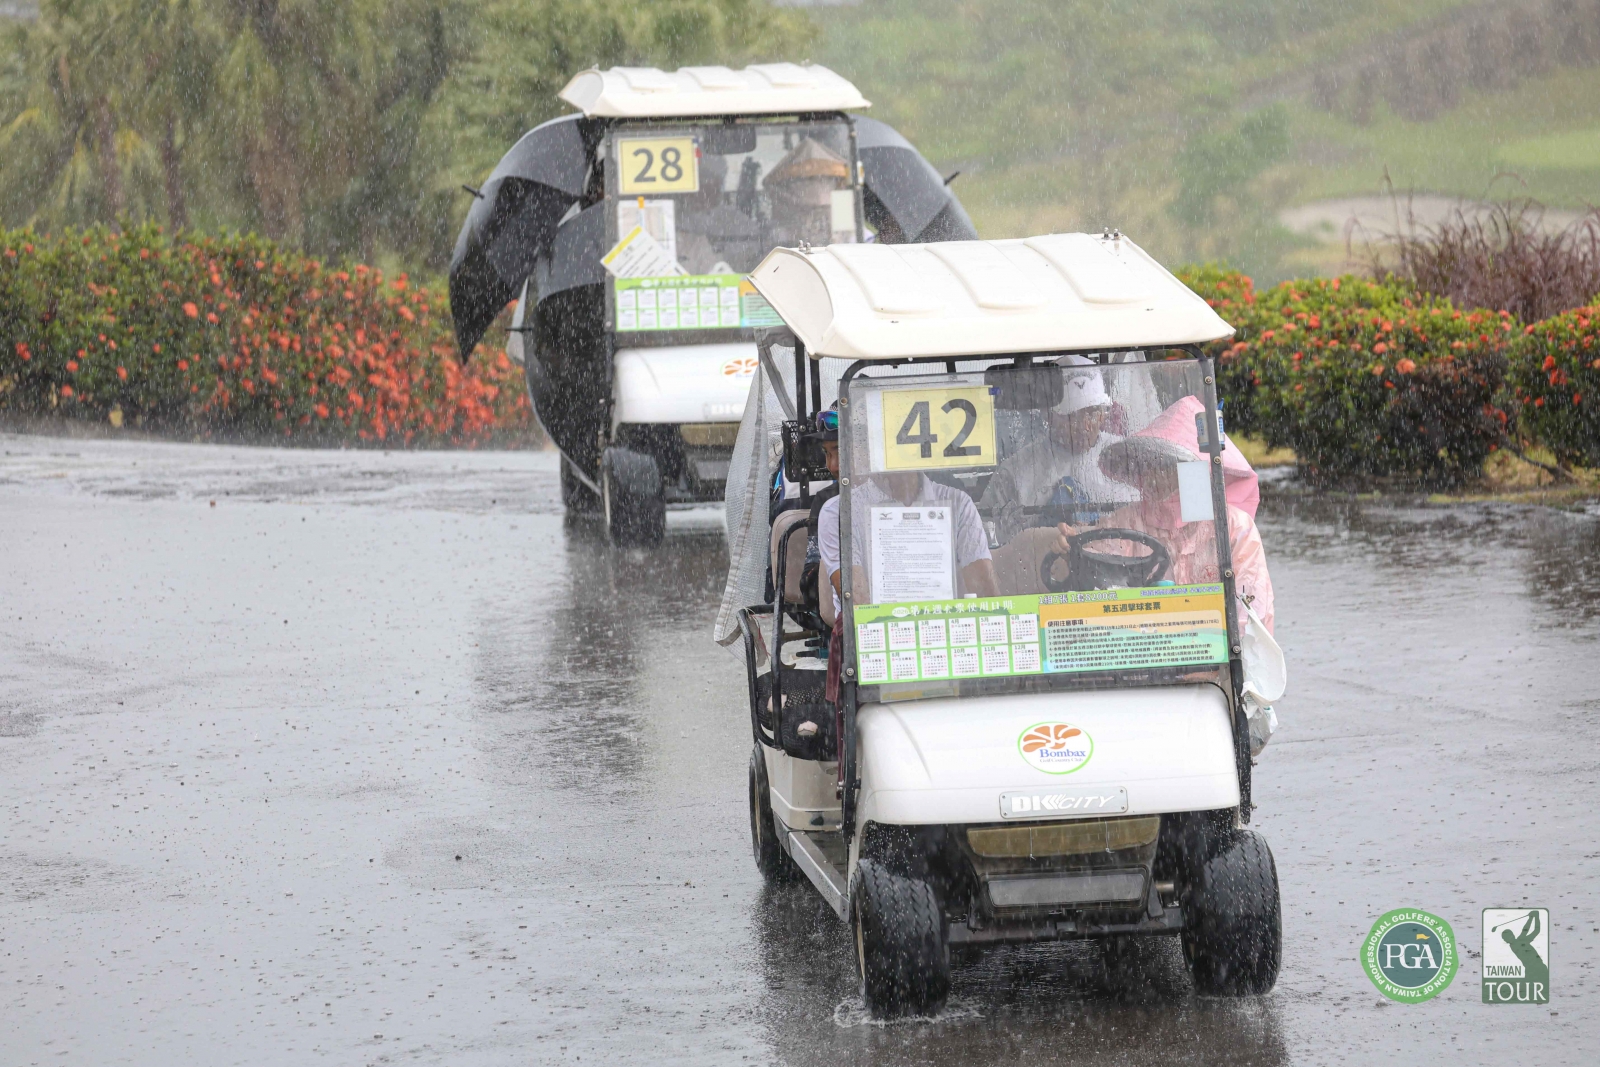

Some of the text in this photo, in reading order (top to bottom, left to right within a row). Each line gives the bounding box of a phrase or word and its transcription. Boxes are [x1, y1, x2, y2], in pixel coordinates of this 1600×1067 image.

[632, 147, 683, 182] 28
[896, 398, 981, 458] 42
[1103, 601, 1161, 613] 第五週擊球套票
[1039, 749, 1086, 758] Bombax
